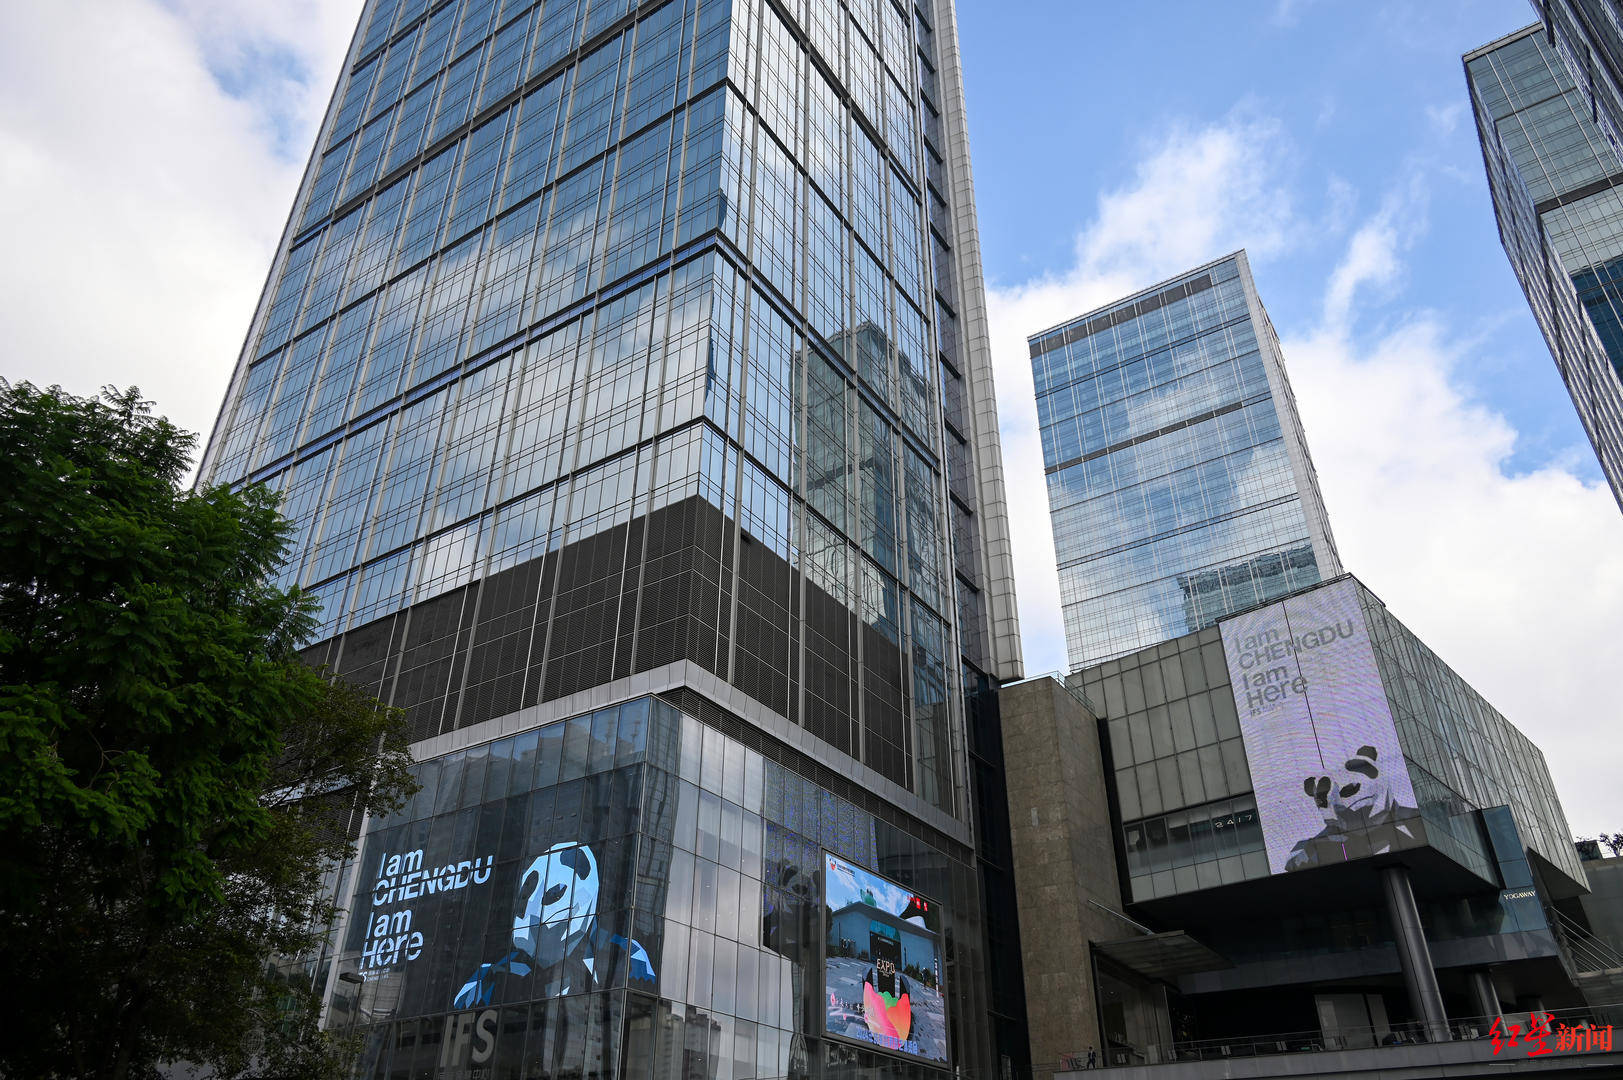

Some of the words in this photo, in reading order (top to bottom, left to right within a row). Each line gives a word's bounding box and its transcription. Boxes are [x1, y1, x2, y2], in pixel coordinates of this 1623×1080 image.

[1238, 619, 1354, 671] CHENGDU
[1244, 628, 1280, 652] am
[1252, 665, 1289, 686] am
[1245, 676, 1308, 709] Here
[376, 852, 386, 879] I
[386, 849, 424, 877] am
[372, 855, 493, 906] CHENGDU
[1503, 890, 1536, 900] YOGAWAY
[366, 911, 374, 939] I
[375, 909, 412, 937] am
[359, 931, 424, 970] Here
[876, 958, 896, 974] EXPO
[440, 1009, 497, 1067] IFS
